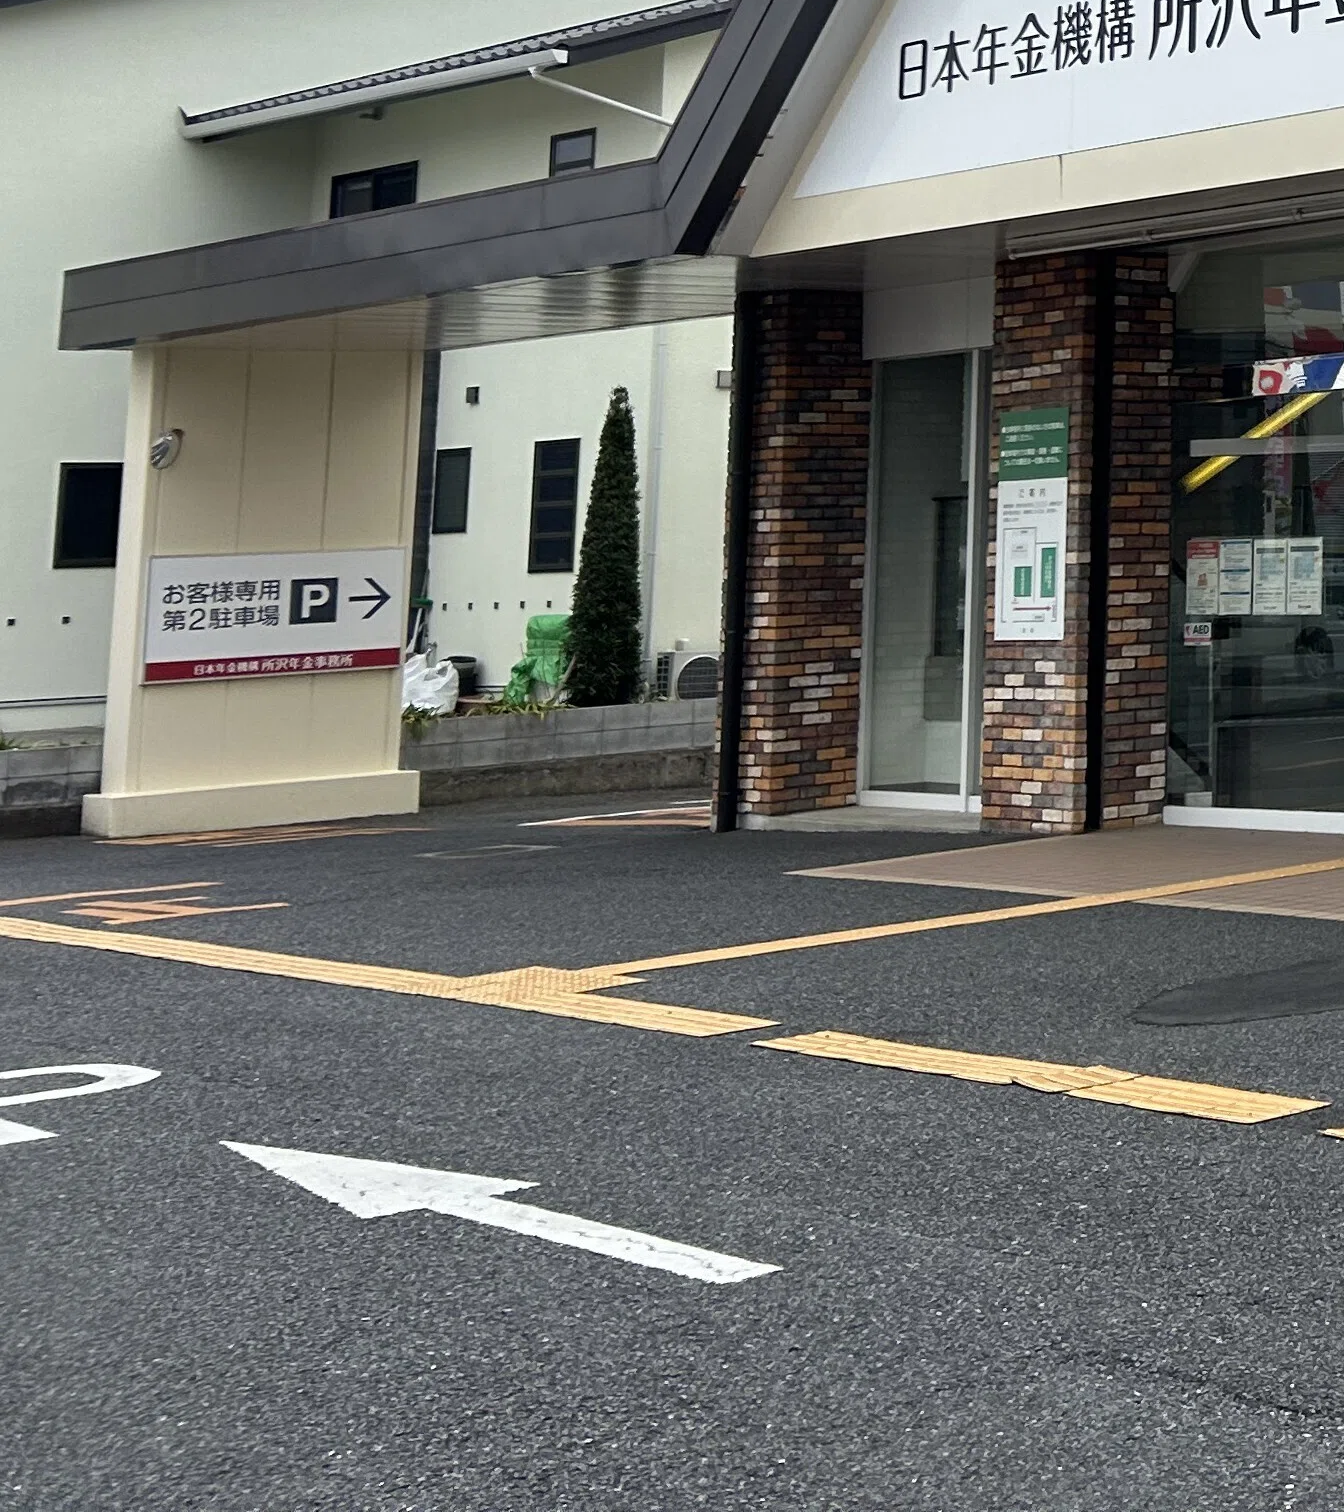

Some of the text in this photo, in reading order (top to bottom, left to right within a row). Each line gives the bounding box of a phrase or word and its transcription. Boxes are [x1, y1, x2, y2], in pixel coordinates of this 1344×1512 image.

[162, 579, 281, 605] お客様専用
[301, 584, 330, 619] P
[162, 604, 281, 632] 第2駐車場
[1192, 624, 1210, 634] AED
[261, 654, 353, 671] 所沢年金事務所
